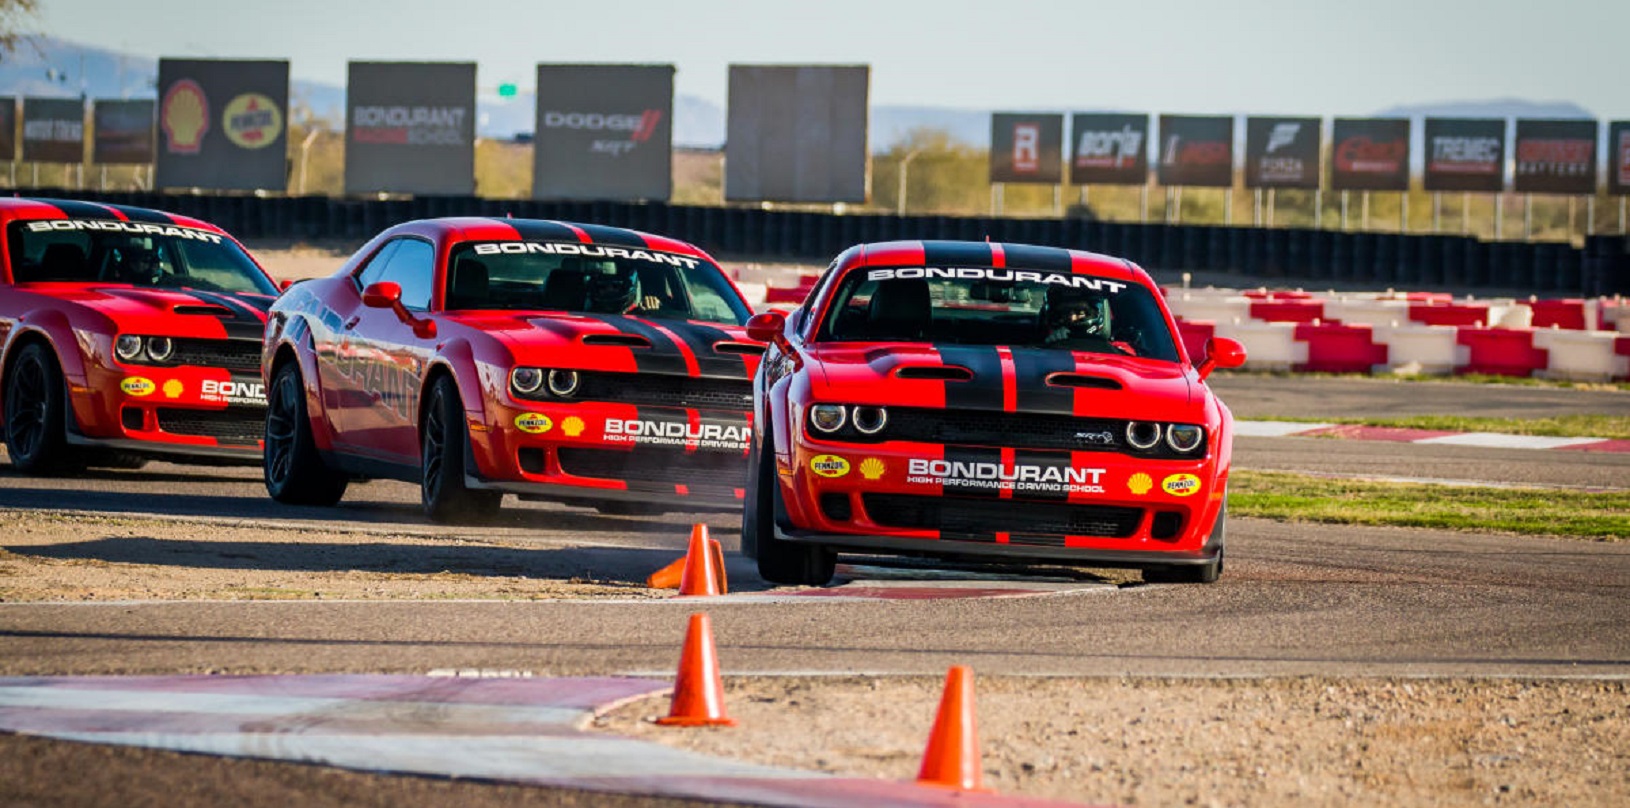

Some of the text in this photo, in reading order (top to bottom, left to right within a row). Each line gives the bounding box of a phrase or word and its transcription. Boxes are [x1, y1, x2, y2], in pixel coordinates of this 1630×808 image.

[353, 106, 466, 126] BONDURANT
[544, 112, 644, 131] DODGE
[1433, 136, 1500, 162] TREMEC
[27, 219, 222, 244] BONDURANT
[474, 242, 699, 269] BONDURANT
[868, 268, 1127, 293] BONDURANT
[603, 434, 626, 442] HIGH
[628, 436, 700, 447] PERFORMANCE
[701, 440, 738, 450] DRIVING
[814, 461, 845, 471] PENNZOIL
[908, 458, 1106, 485] BONDURANT
[906, 476, 1105, 494] HIGH PERFORMANCE DRIVING SCHOOL
[1166, 480, 1196, 490] PENNZOIL
